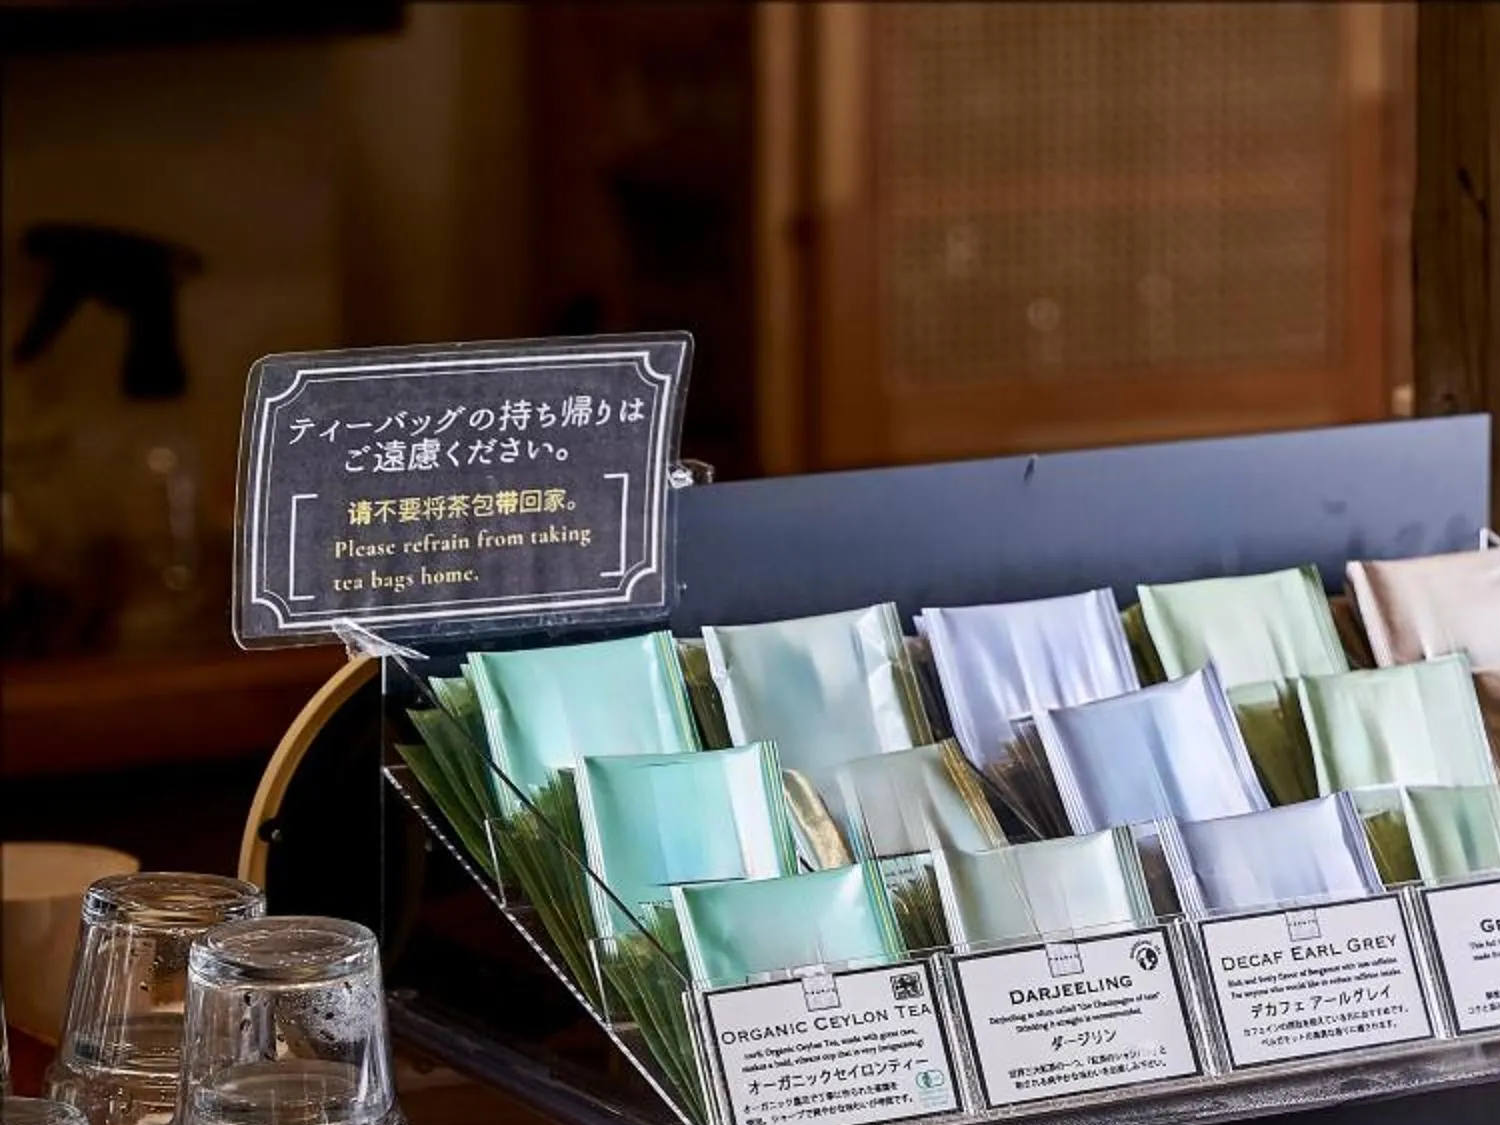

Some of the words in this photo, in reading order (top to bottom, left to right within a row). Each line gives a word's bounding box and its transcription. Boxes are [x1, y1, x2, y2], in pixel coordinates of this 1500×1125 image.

[287, 395, 646, 446] ティーバッグの持ち帰りは
[344, 437, 570, 474] ご遠慮ください。
[347, 488, 577, 526] 请不要将茶包带回家。
[334, 539, 397, 559] Please
[402, 533, 470, 554] refrain
[477, 529, 525, 549] from
[530, 525, 592, 547] taking
[333, 576, 364, 592] tea
[371, 570, 415, 593] bags
[420, 565, 480, 587] home.
[1220, 950, 1283, 972] DECAF
[1290, 943, 1343, 962] EARL
[1346, 934, 1397, 953] GREY
[1008, 975, 1133, 1006] DARJEELING
[1251, 1001, 1305, 1020] デカフェ
[1309, 983, 1390, 1011] アールグレイ
[720, 1021, 808, 1045] ORGANIC
[813, 1009, 889, 1031] CEYLON
[893, 1003, 933, 1019] TEA
[1051, 1029, 1117, 1052] ダージリン
[748, 1058, 929, 1096] オーガニックセイロンティー
